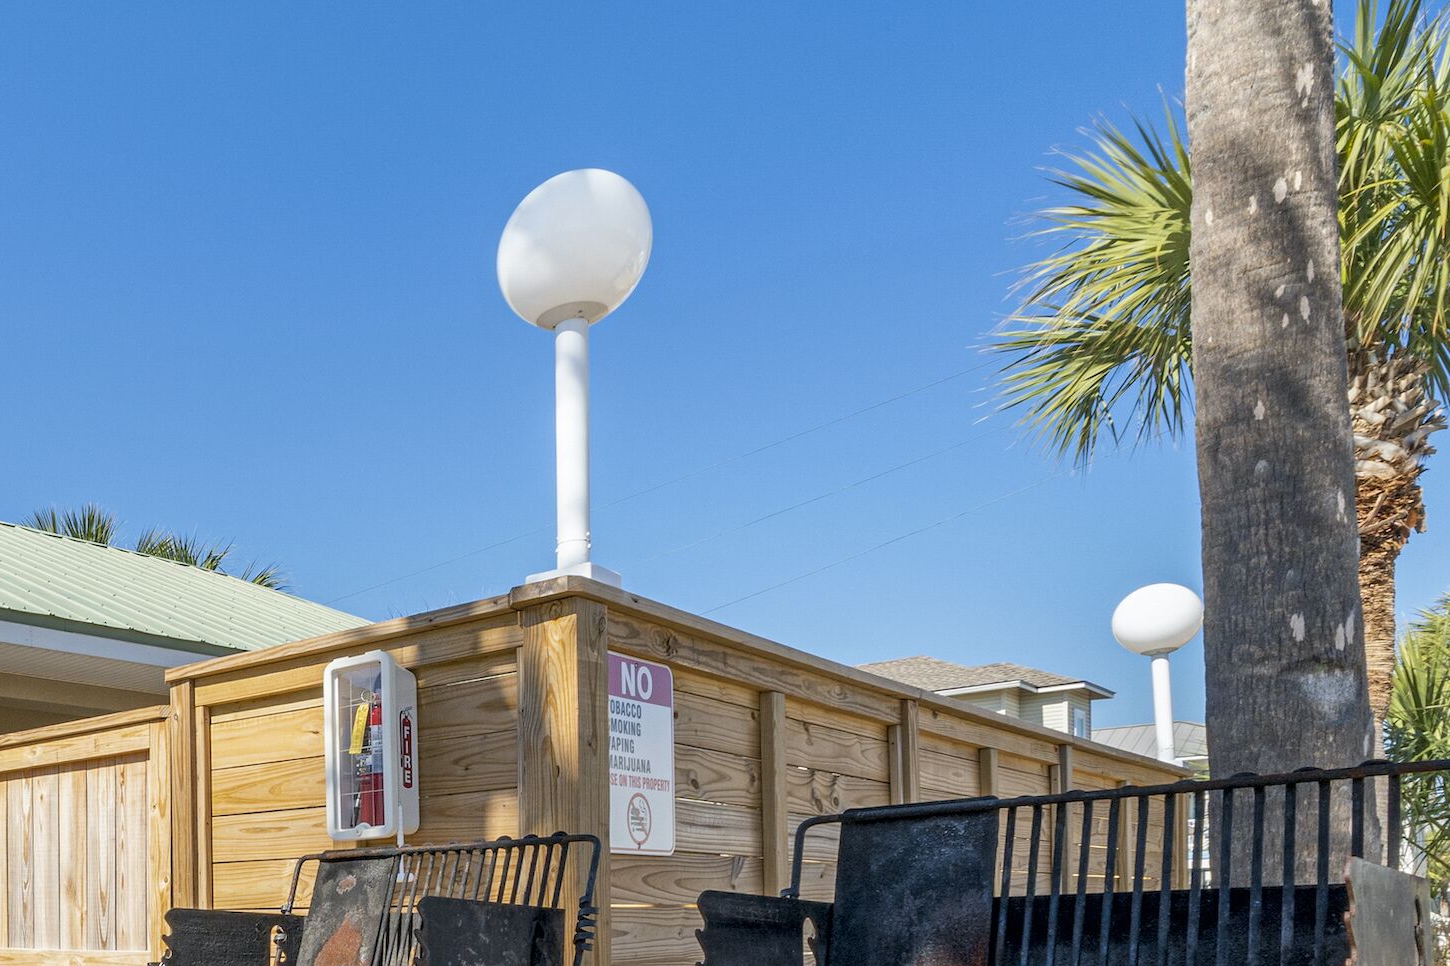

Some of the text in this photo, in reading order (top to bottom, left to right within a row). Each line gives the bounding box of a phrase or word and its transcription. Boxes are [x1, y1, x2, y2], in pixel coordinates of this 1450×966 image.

[620, 661, 653, 700] NO
[610, 699, 642, 719] OBACCO
[610, 718, 641, 736] MOKING
[404, 726, 412, 784] FIRE
[609, 736, 635, 754] APING
[610, 773, 670, 793] SE ON THIS PROPERTY
